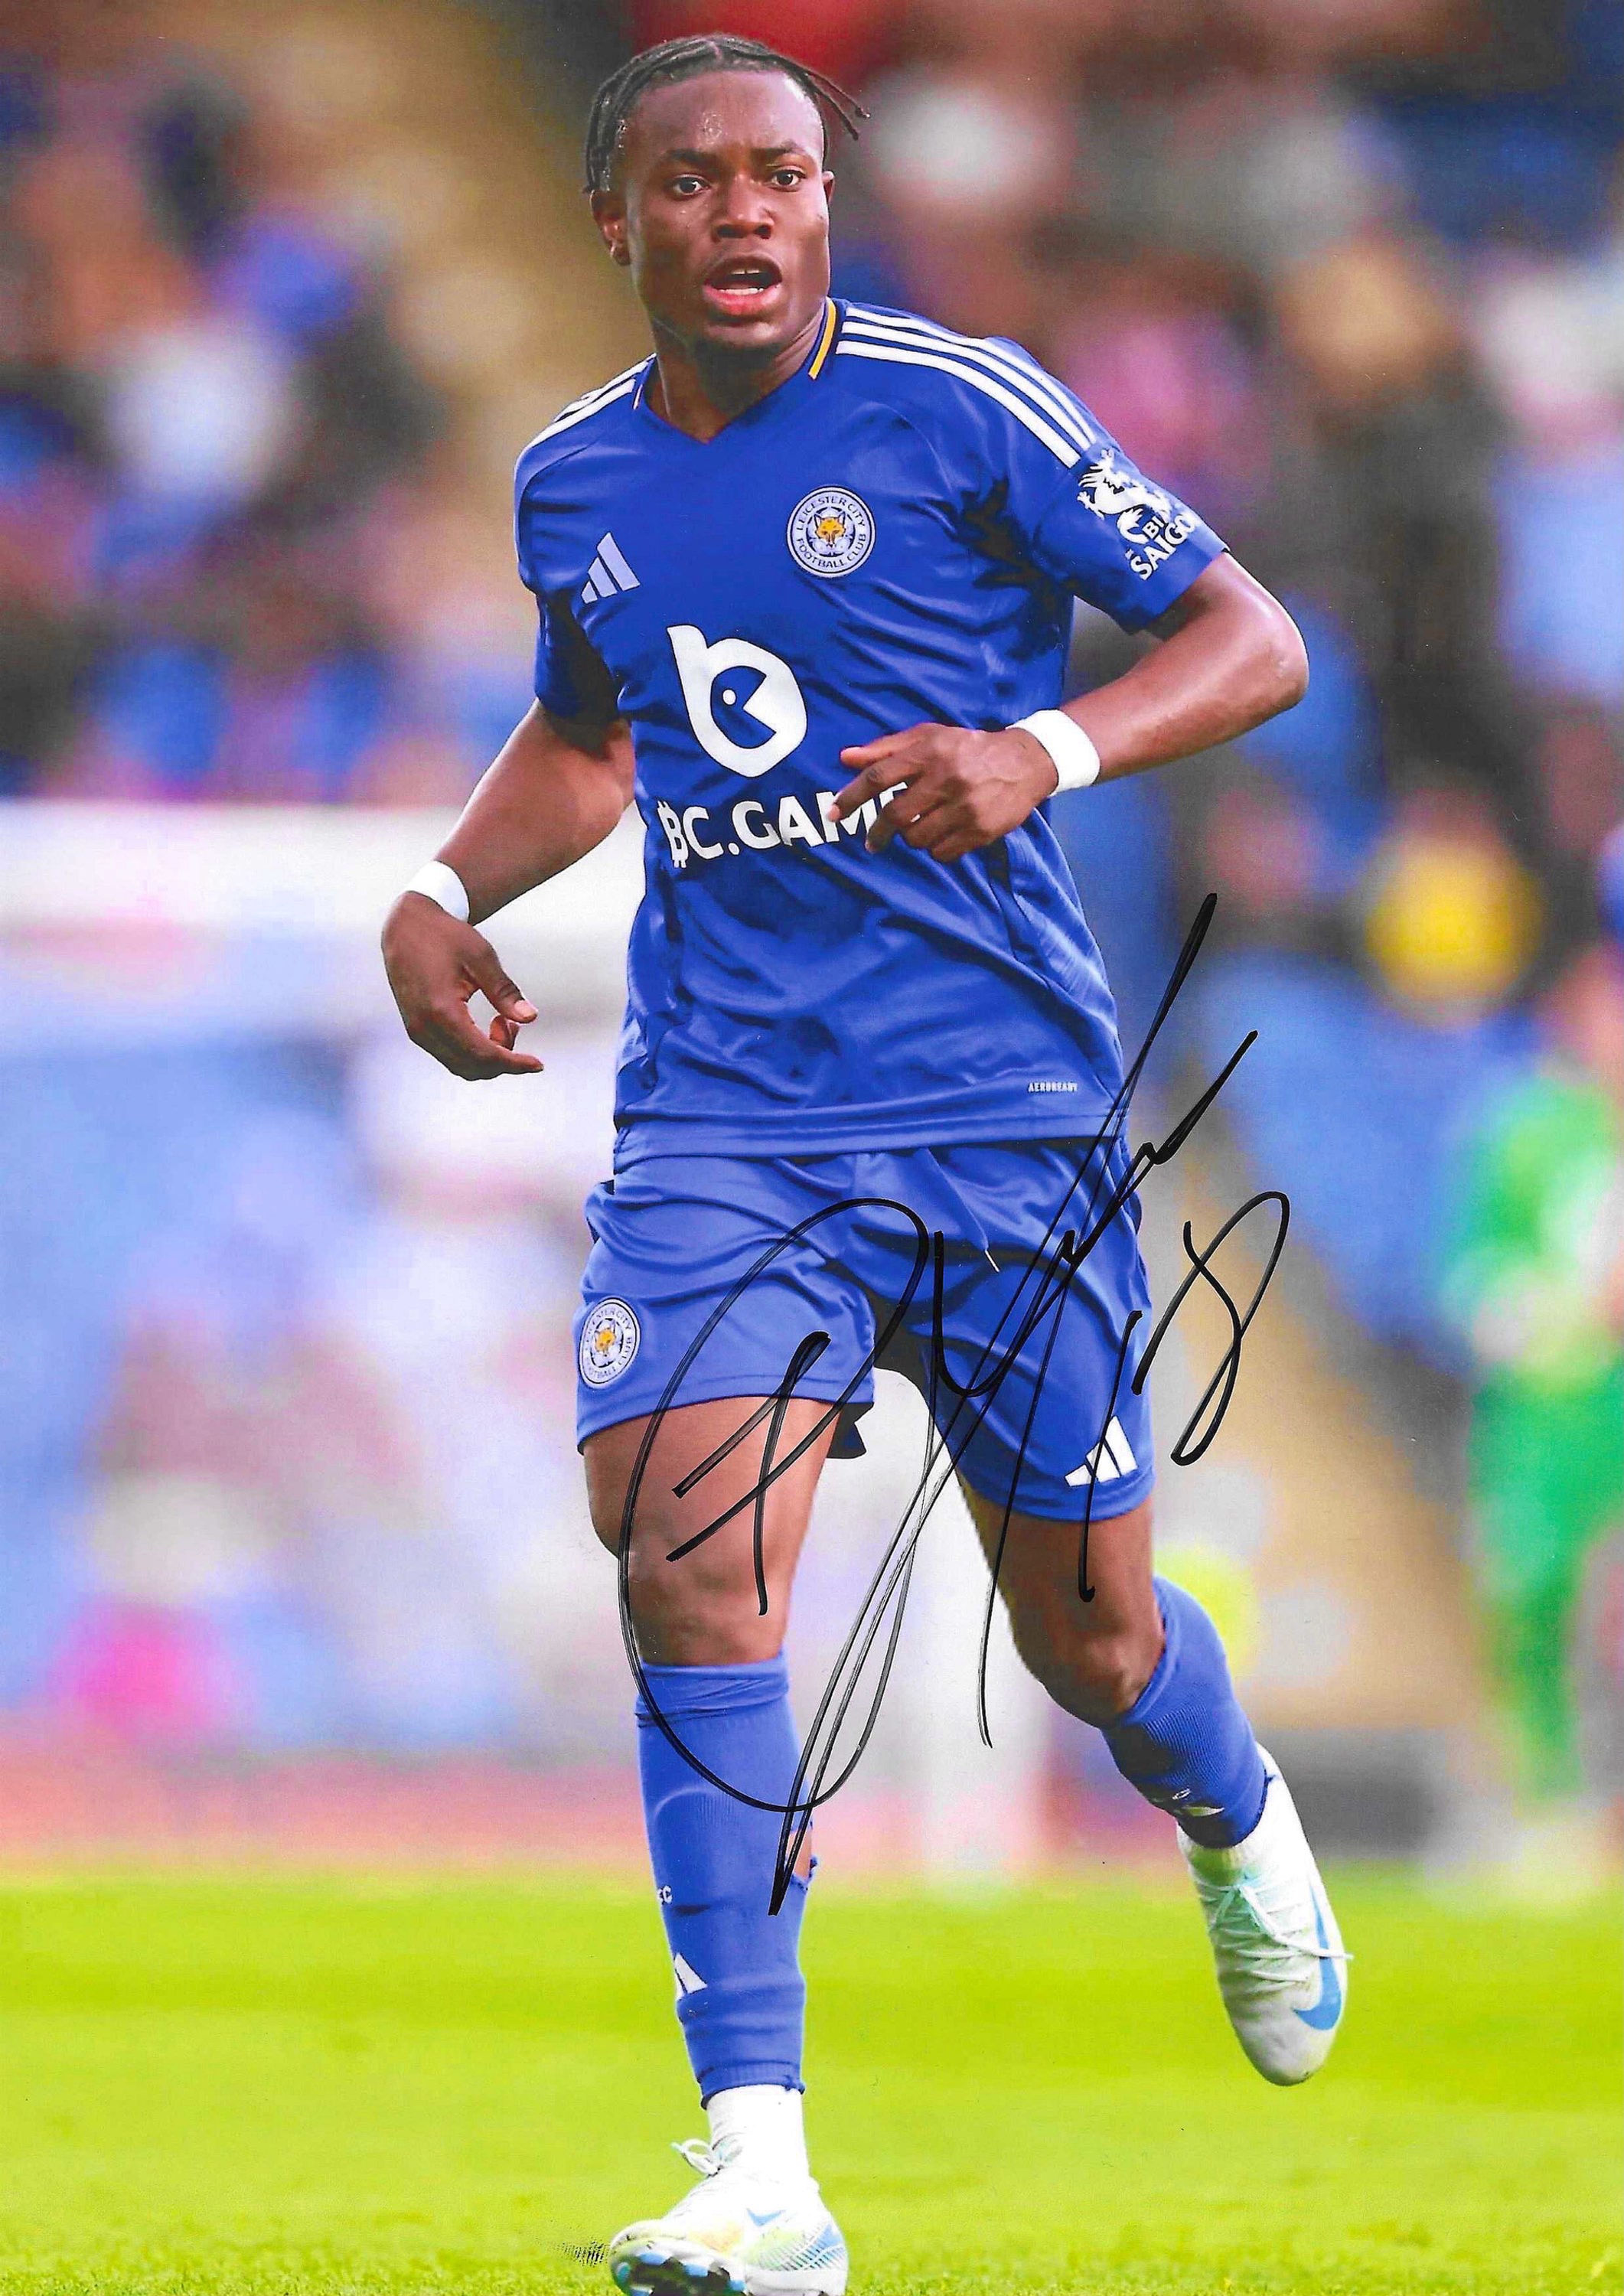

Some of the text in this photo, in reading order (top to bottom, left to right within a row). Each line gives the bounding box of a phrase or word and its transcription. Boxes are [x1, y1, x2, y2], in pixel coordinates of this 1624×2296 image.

[796, 496, 866, 531] LEICESTER CITY
[796, 533, 867, 569] FOOTBALL CLUB
